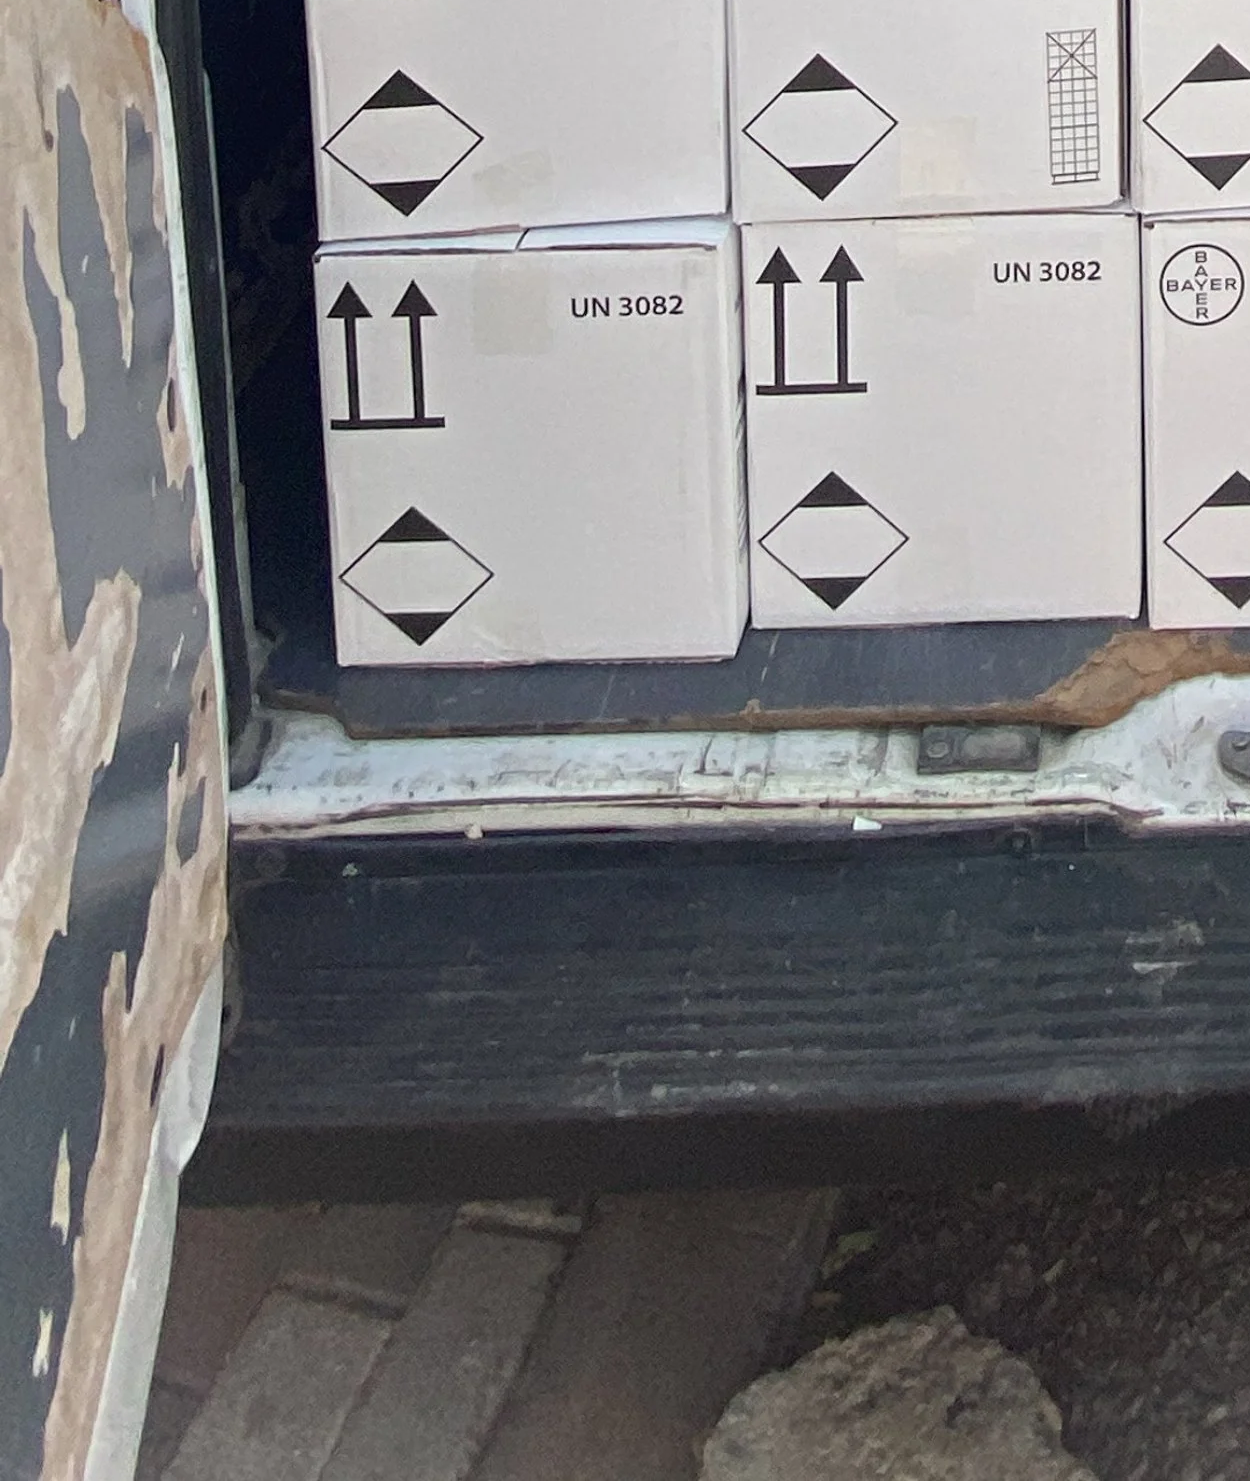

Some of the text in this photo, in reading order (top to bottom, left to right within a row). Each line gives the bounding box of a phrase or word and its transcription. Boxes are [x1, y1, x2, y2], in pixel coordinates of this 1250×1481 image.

[994, 261, 1101, 283] UN 3082
[1167, 278, 1237, 292] BAYER
[1195, 251, 1208, 319] BAYER
[571, 295, 684, 318] UN 3082
